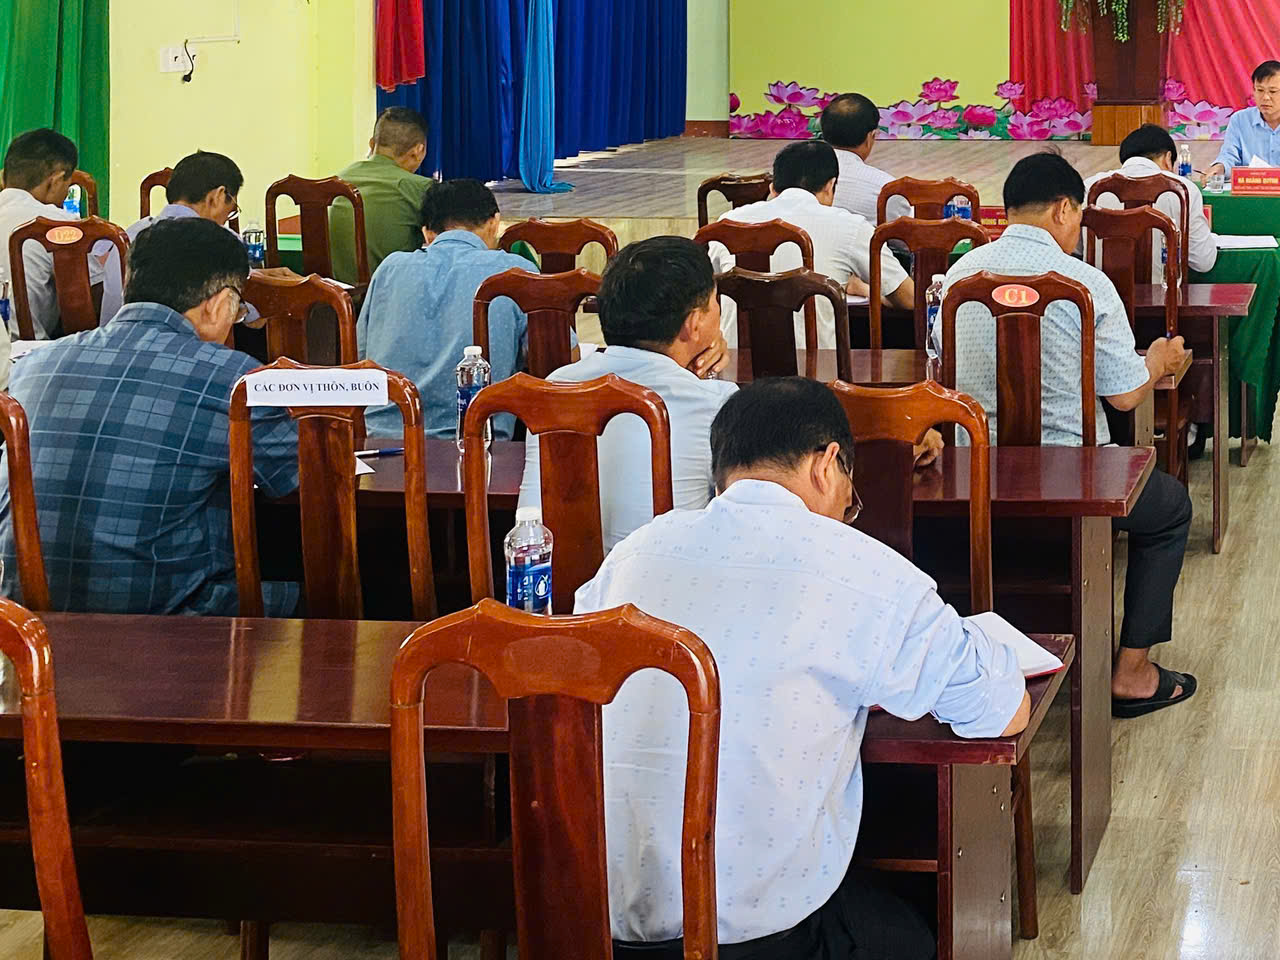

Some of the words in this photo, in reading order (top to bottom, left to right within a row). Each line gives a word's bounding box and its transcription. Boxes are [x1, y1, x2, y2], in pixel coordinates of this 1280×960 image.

[254, 381, 276, 392] CÁC
[279, 383, 300, 392] ĐƠN
[303, 383, 314, 394] VỊ
[351, 381, 380, 392] BUÔN
